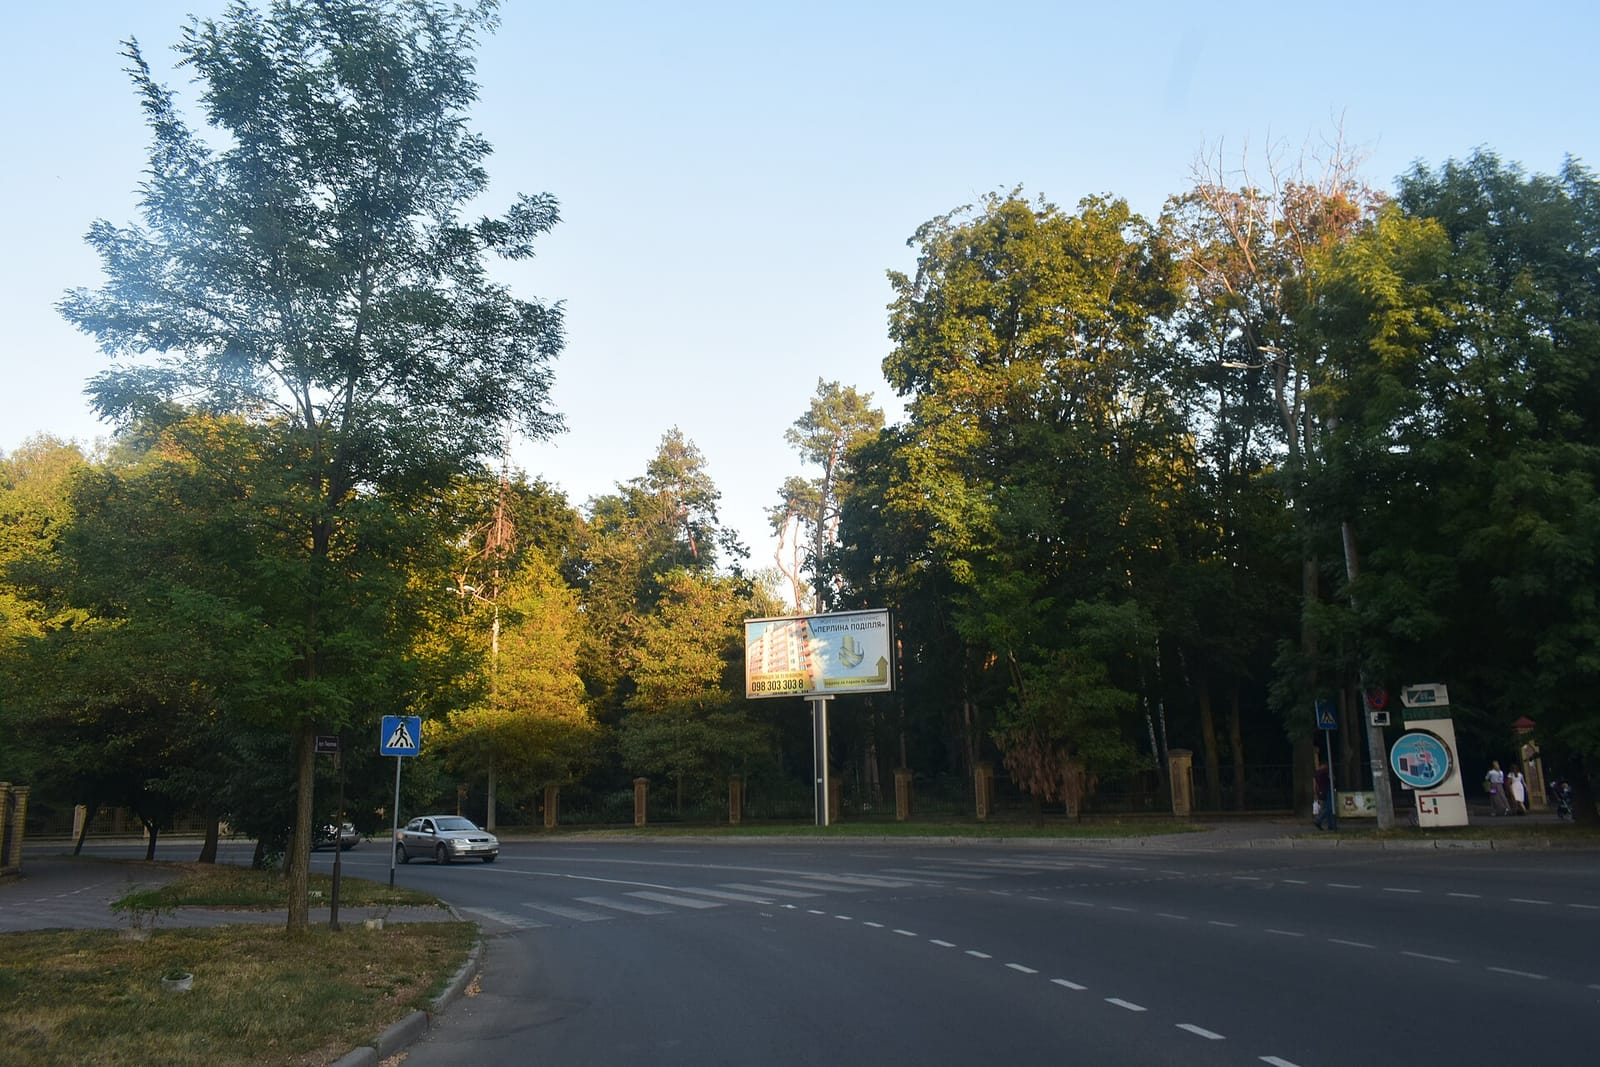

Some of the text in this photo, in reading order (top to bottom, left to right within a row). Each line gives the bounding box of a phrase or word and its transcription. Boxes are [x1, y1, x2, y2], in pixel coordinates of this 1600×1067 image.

[814, 621, 885, 633] «ПЕРЛИНА ПОДІЛЛЯ»
[751, 679, 804, 692] 098 303 303 8
